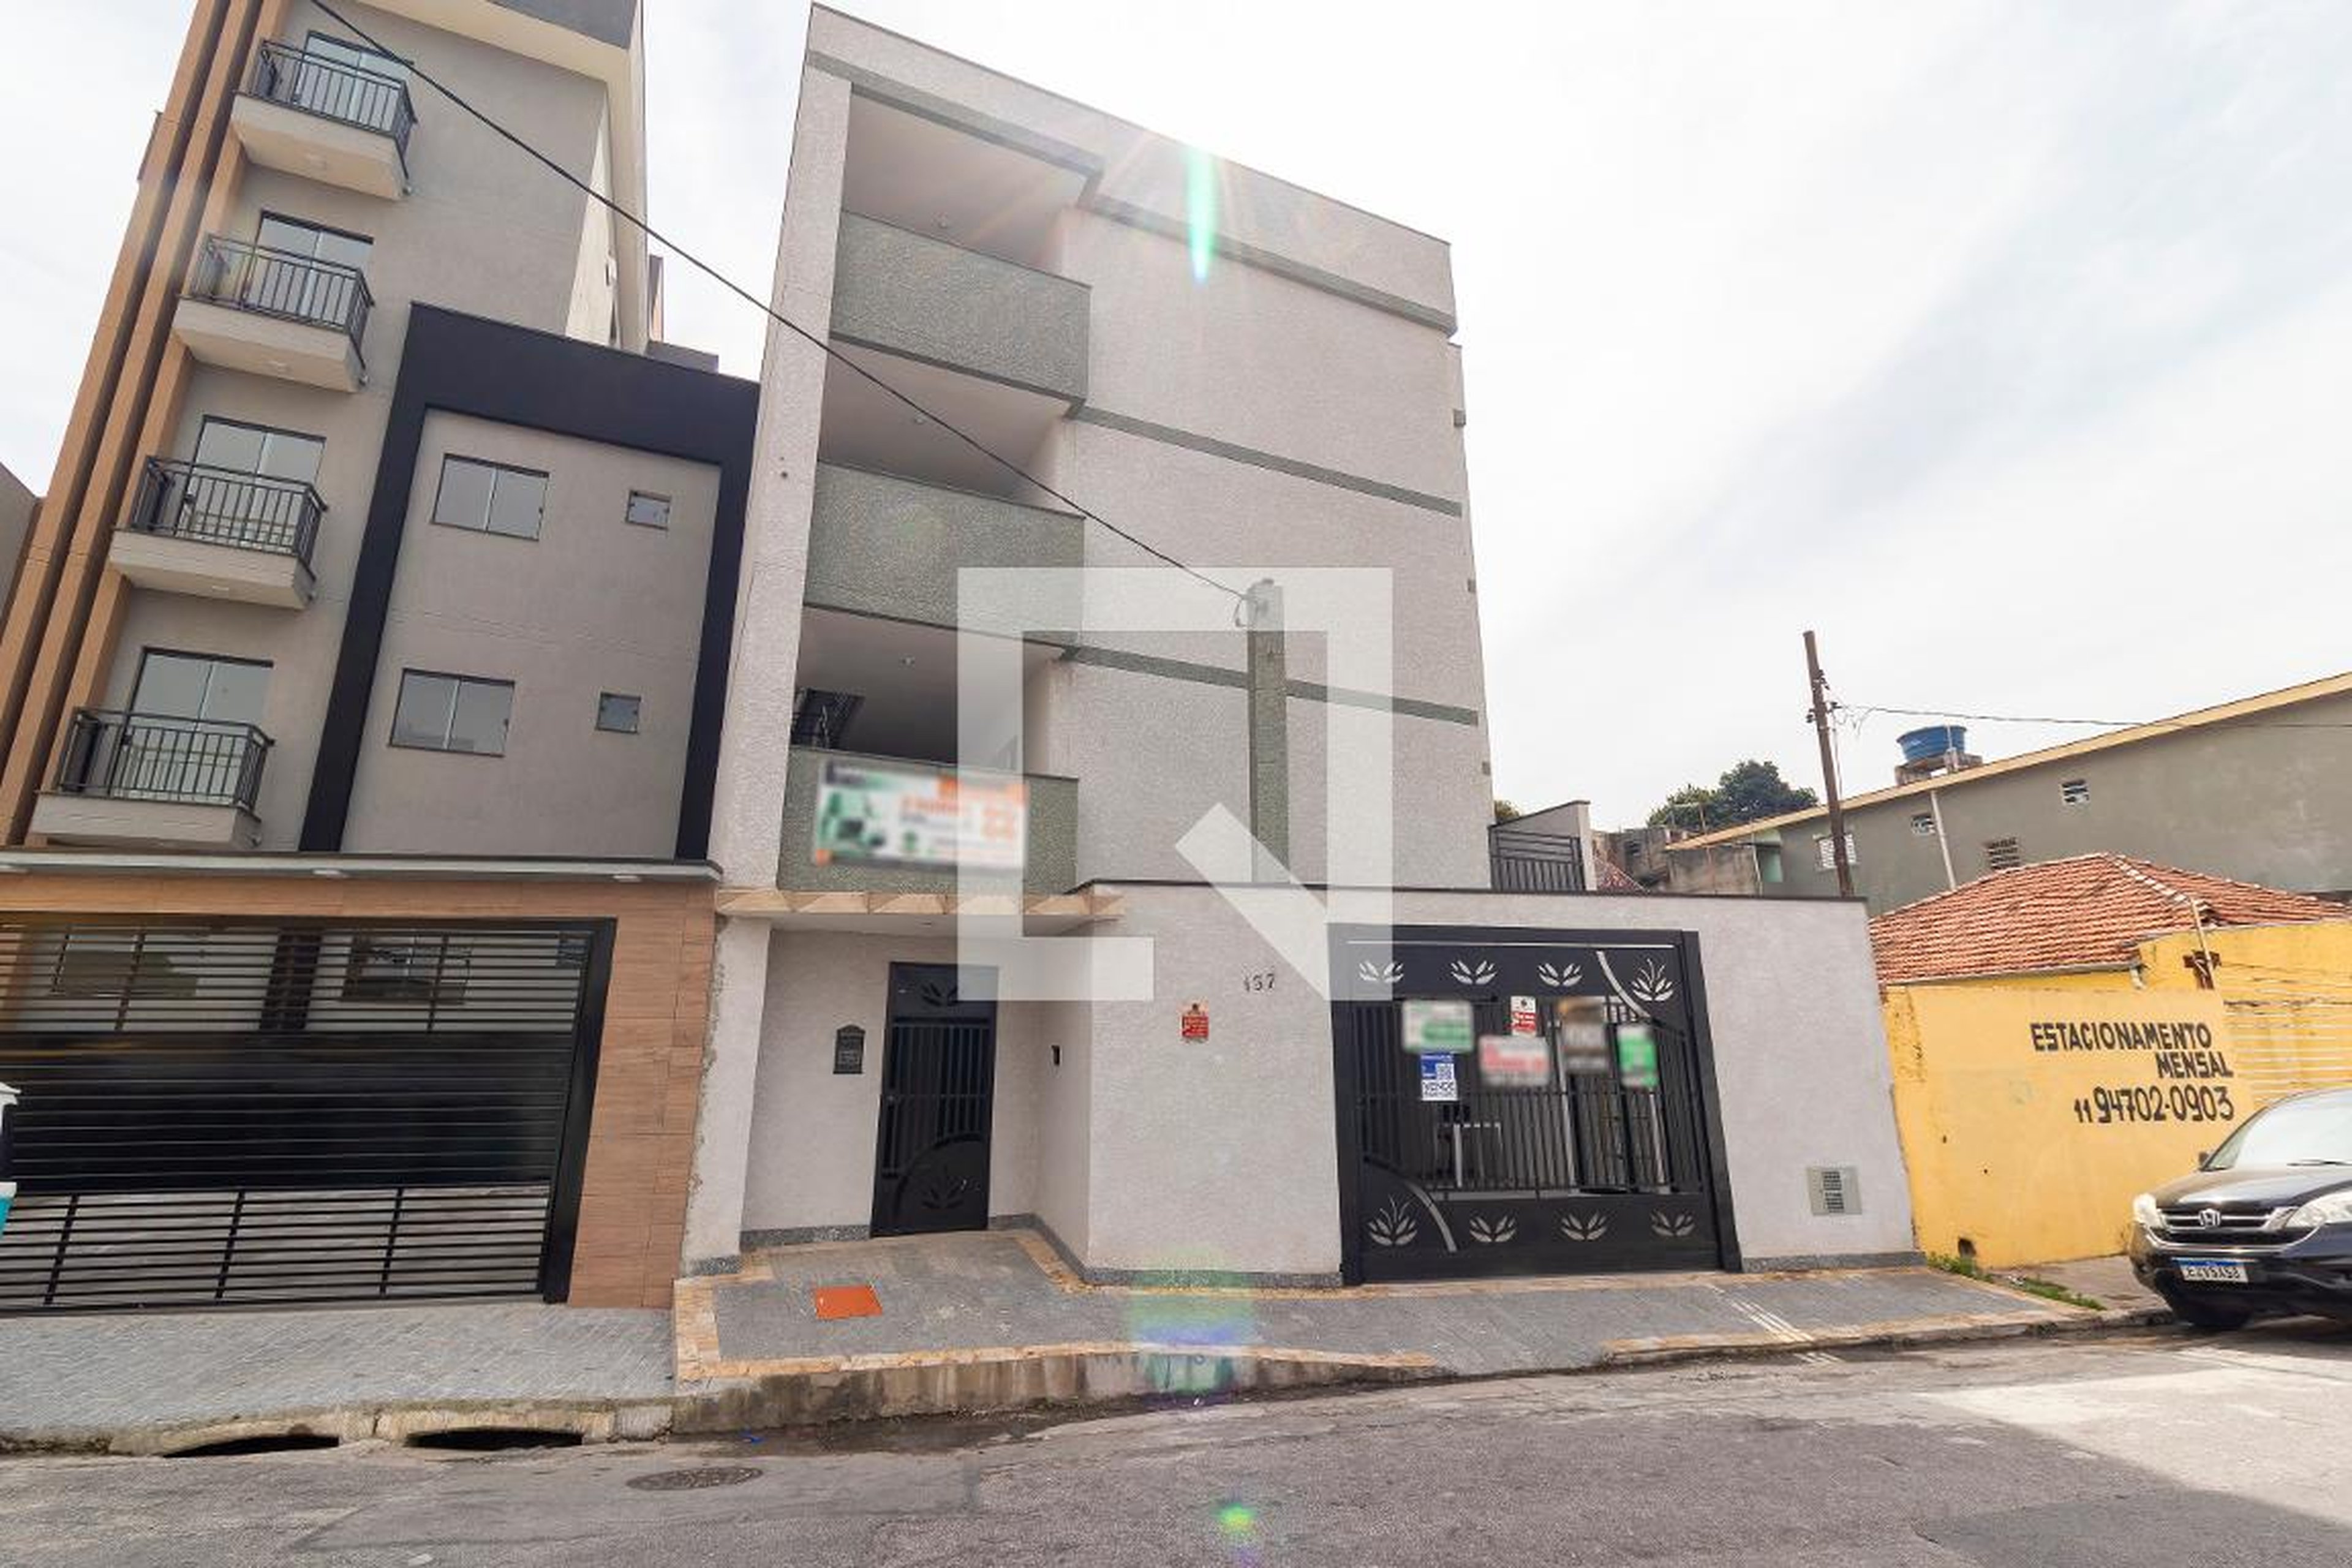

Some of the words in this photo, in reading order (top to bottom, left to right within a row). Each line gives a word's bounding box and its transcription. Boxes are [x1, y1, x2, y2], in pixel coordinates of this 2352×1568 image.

[2030, 1022, 2212, 1051] ESTACIONAMENTO
[2155, 1051, 2234, 1078] MENSAL
[2074, 1098, 2092, 1123] 11
